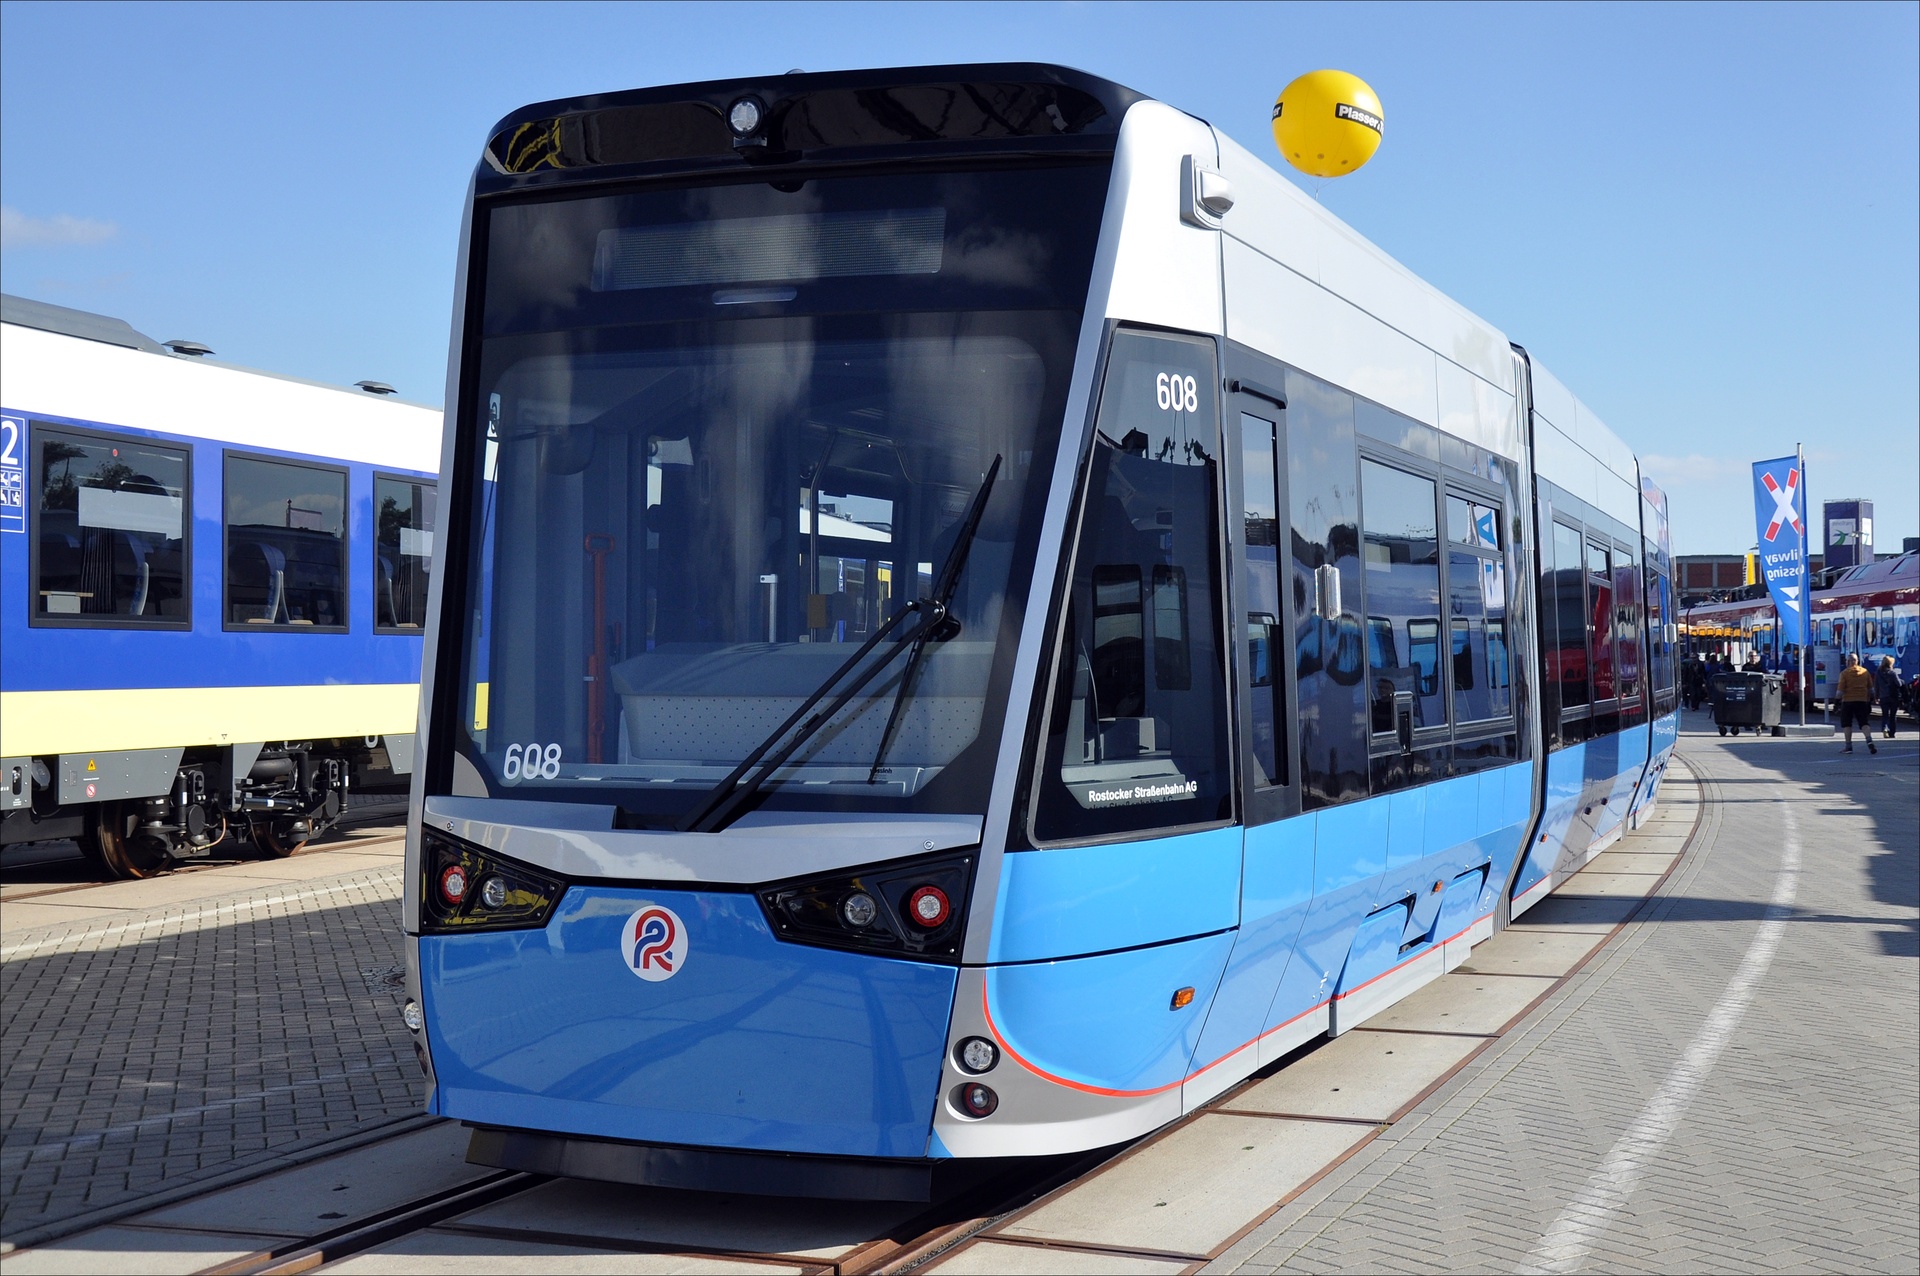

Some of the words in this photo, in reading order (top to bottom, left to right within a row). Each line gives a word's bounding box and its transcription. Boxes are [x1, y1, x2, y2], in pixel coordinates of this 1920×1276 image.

[1338, 105, 1379, 128] Plasser
[1156, 372, 1198, 413] 608
[1, 420, 18, 466] 2
[503, 743, 562, 780] 608
[1088, 788, 1133, 802] Rostocker
[1134, 783, 1185, 798] Straßenbahn
[1185, 781, 1197, 793] AG
